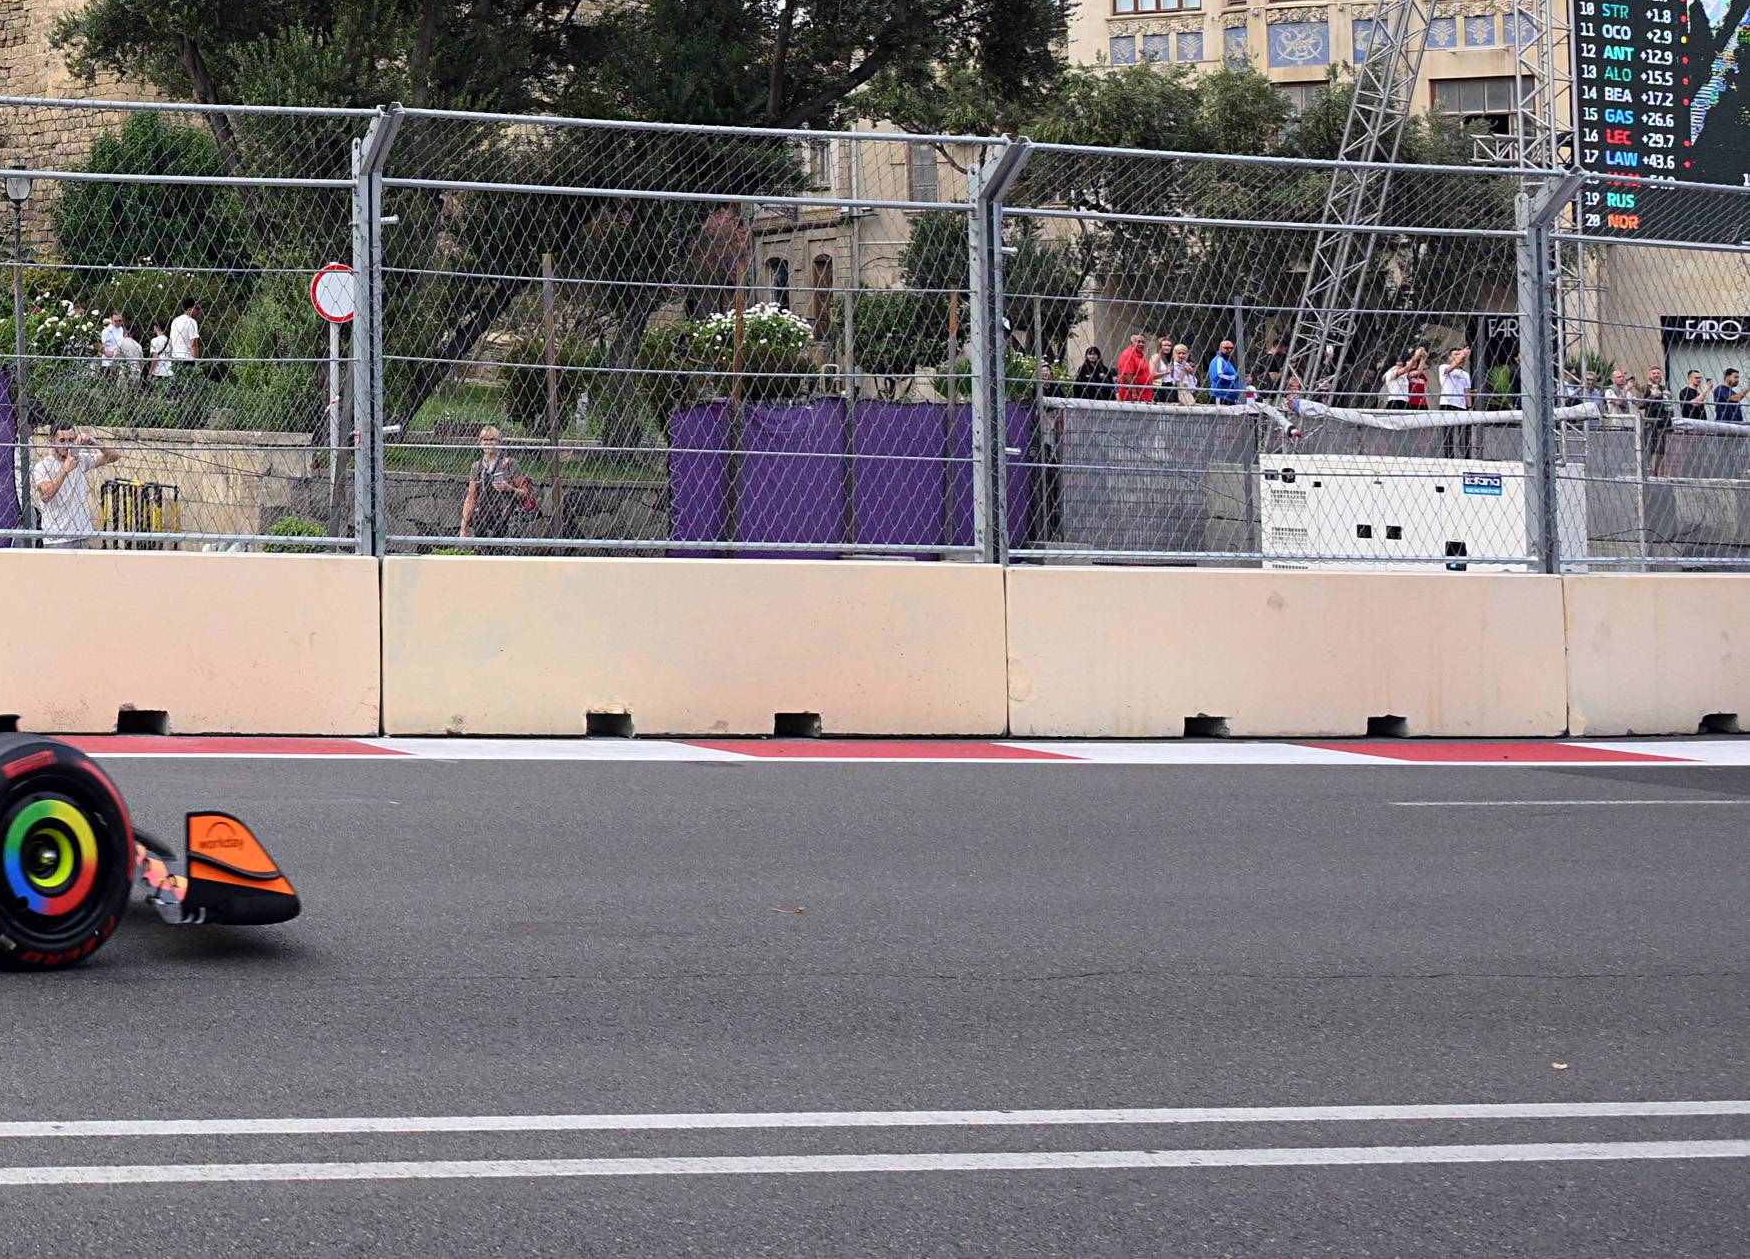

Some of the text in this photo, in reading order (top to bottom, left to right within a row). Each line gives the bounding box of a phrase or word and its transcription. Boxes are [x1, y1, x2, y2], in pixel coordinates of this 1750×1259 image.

[1602, 3, 1629, 19] STR
[1646, 9, 1671, 23] +1.8
[1580, 22, 1672, 44] 11 OCO +2.9
[1581, 43, 1673, 65] 12 ANT +12.9
[1581, 65, 1673, 86] 13 ALO +15.5
[1582, 86, 1673, 106] 14 BEA +17.2
[1583, 107, 1674, 127] 15 GAS +26.6
[1583, 128, 1674, 148] 16 LEC +29.7
[1584, 149, 1675, 169] 17 LAW +43.6
[1585, 192, 1635, 209] 19 RUS
[1585, 213, 1640, 230] 20 NOR
[1488, 318, 1519, 338] FAR
[1685, 319, 1742, 340] FARO
